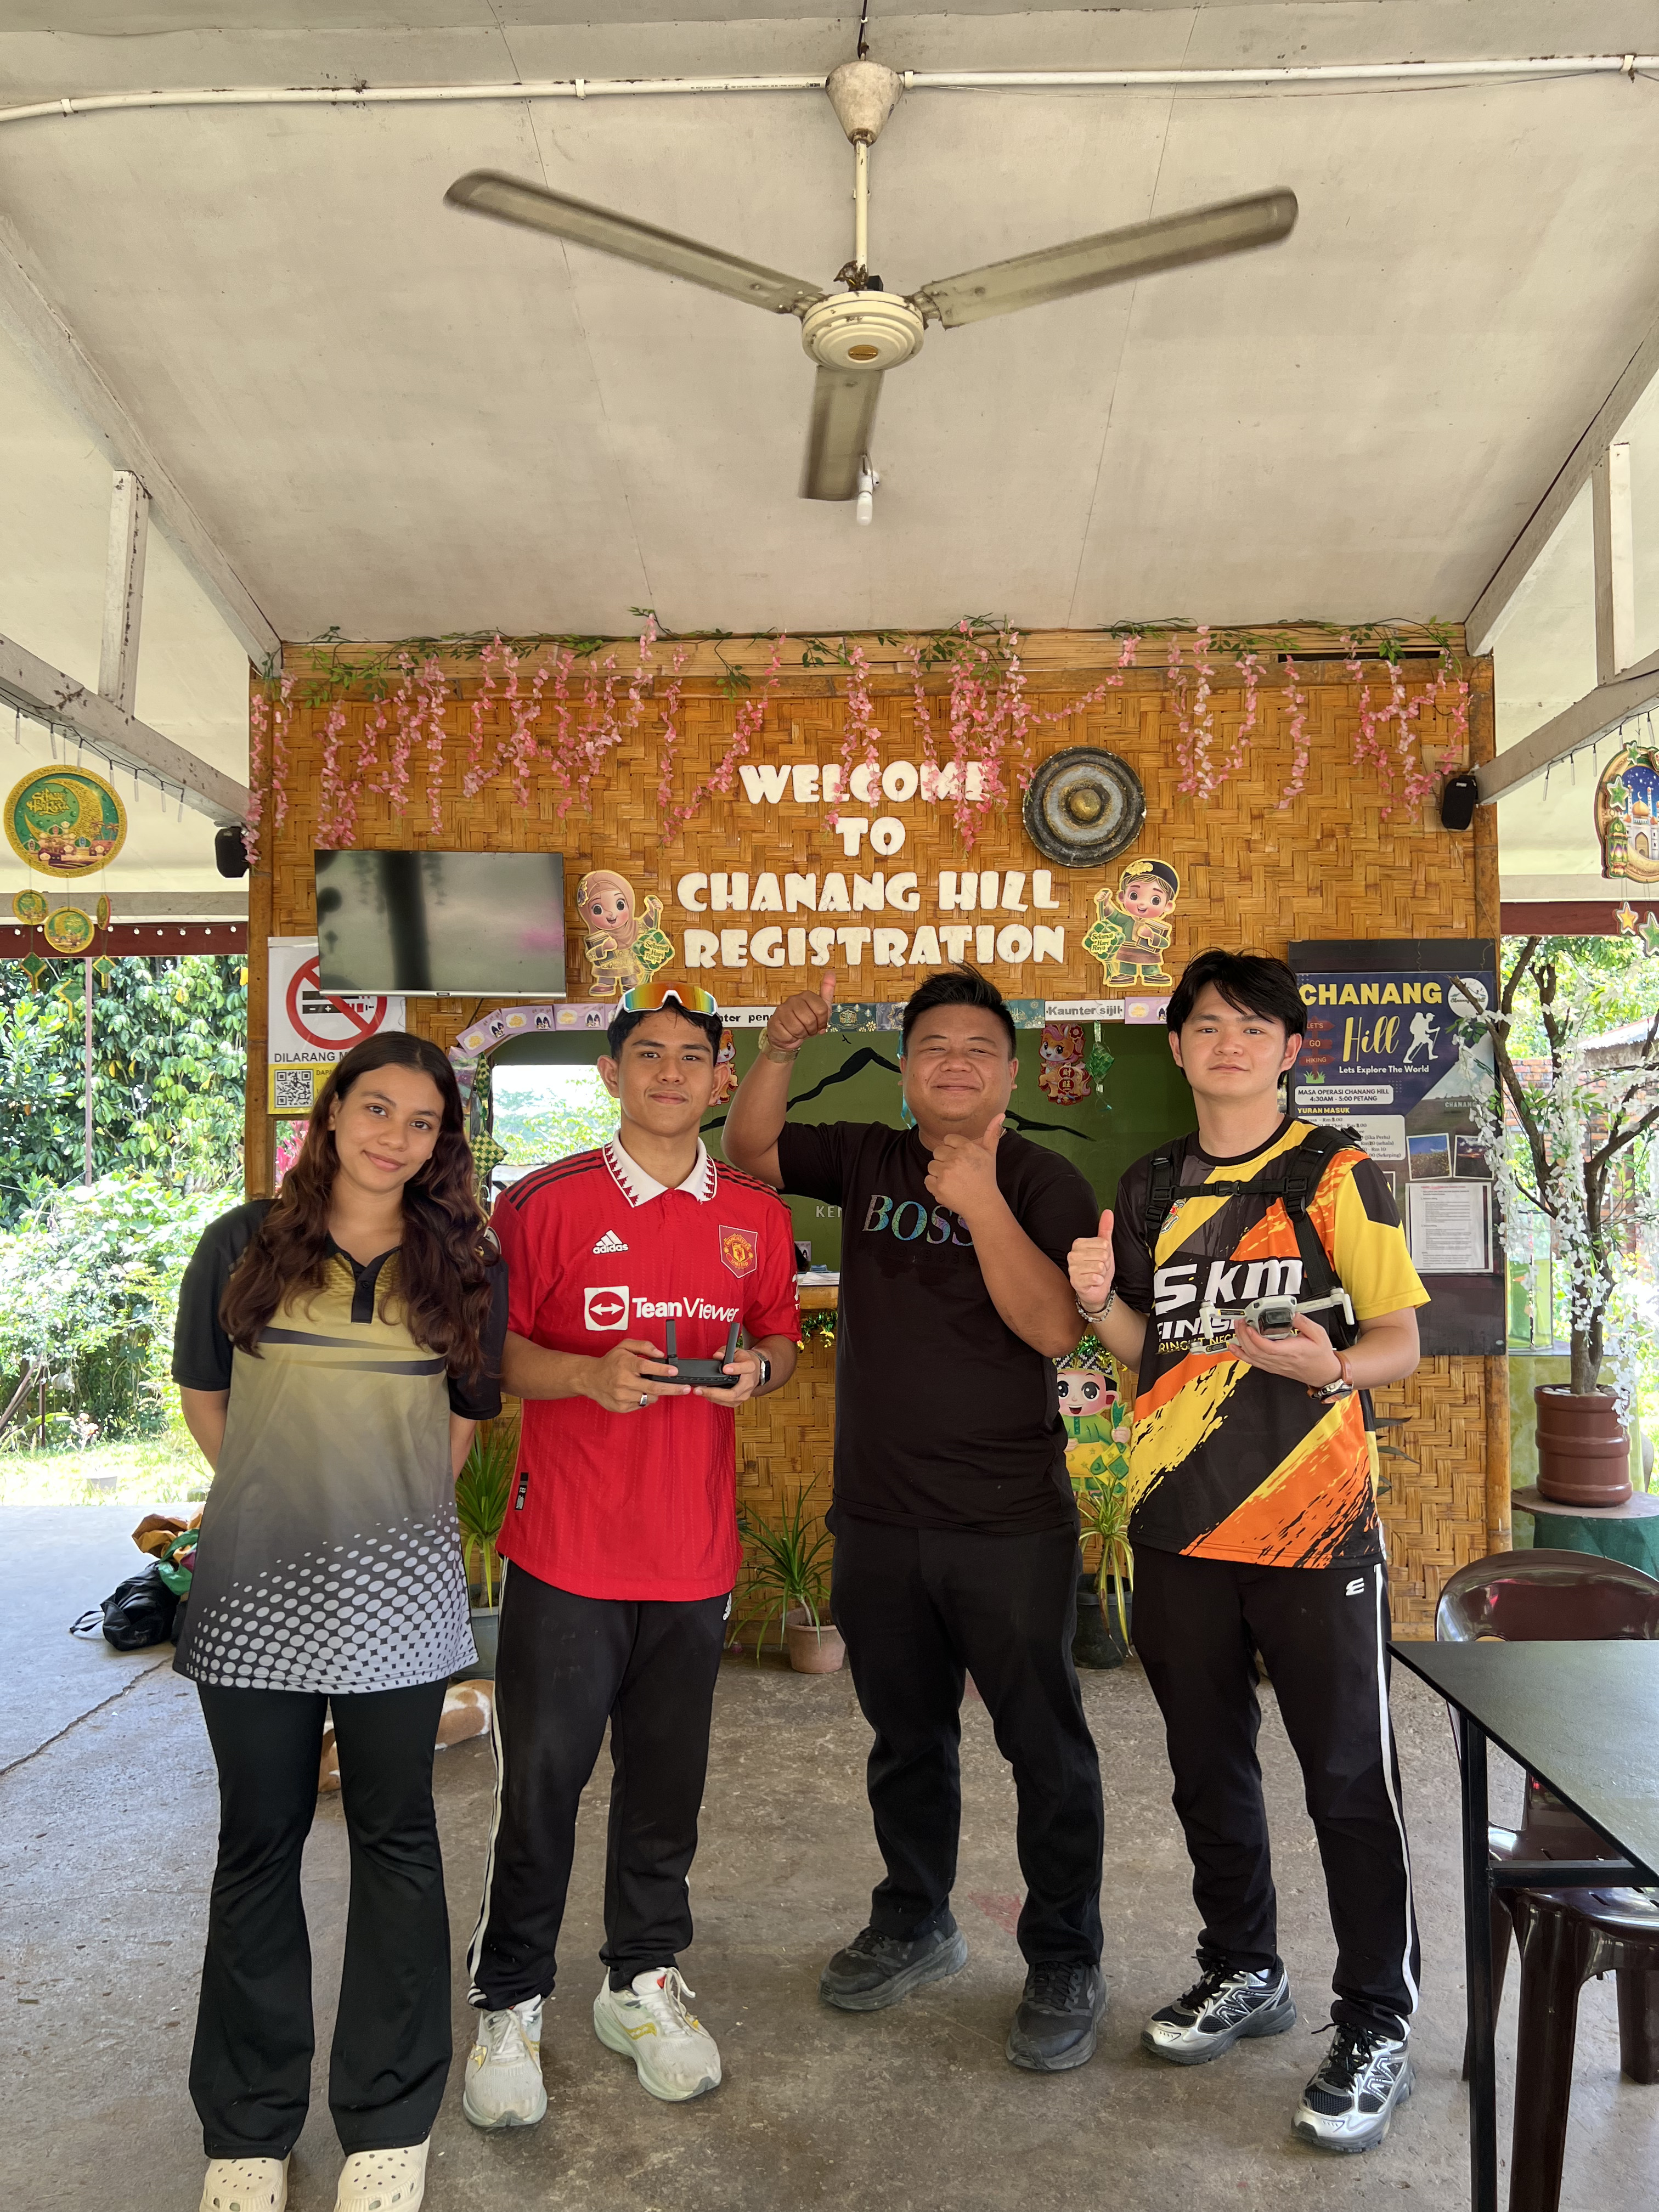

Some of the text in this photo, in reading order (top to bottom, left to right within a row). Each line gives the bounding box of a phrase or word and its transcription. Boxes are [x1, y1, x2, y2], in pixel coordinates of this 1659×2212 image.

[739, 760, 990, 804] WELCOME
[836, 816, 906, 856] TO
[677, 870, 1059, 912] CHANANG HILL
[646, 941, 668, 951] Selamat
[651, 949, 664, 958] Hari
[684, 923, 1064, 969] REGISTRATION
[646, 952, 661, 962] Raya
[1299, 982, 1442, 1006] CHANANG
[1048, 1006, 1096, 1015] Kaunter
[1099, 1006, 1120, 1016] sijil
[1342, 1015, 1400, 1062] Hill
[274, 1052, 335, 1062] DILARANG
[1357, 1066, 1387, 1075] Explore
[1404, 1065, 1429, 1073] World
[862, 1194, 973, 1246] BOSS
[592, 1243, 629, 1254] adidas
